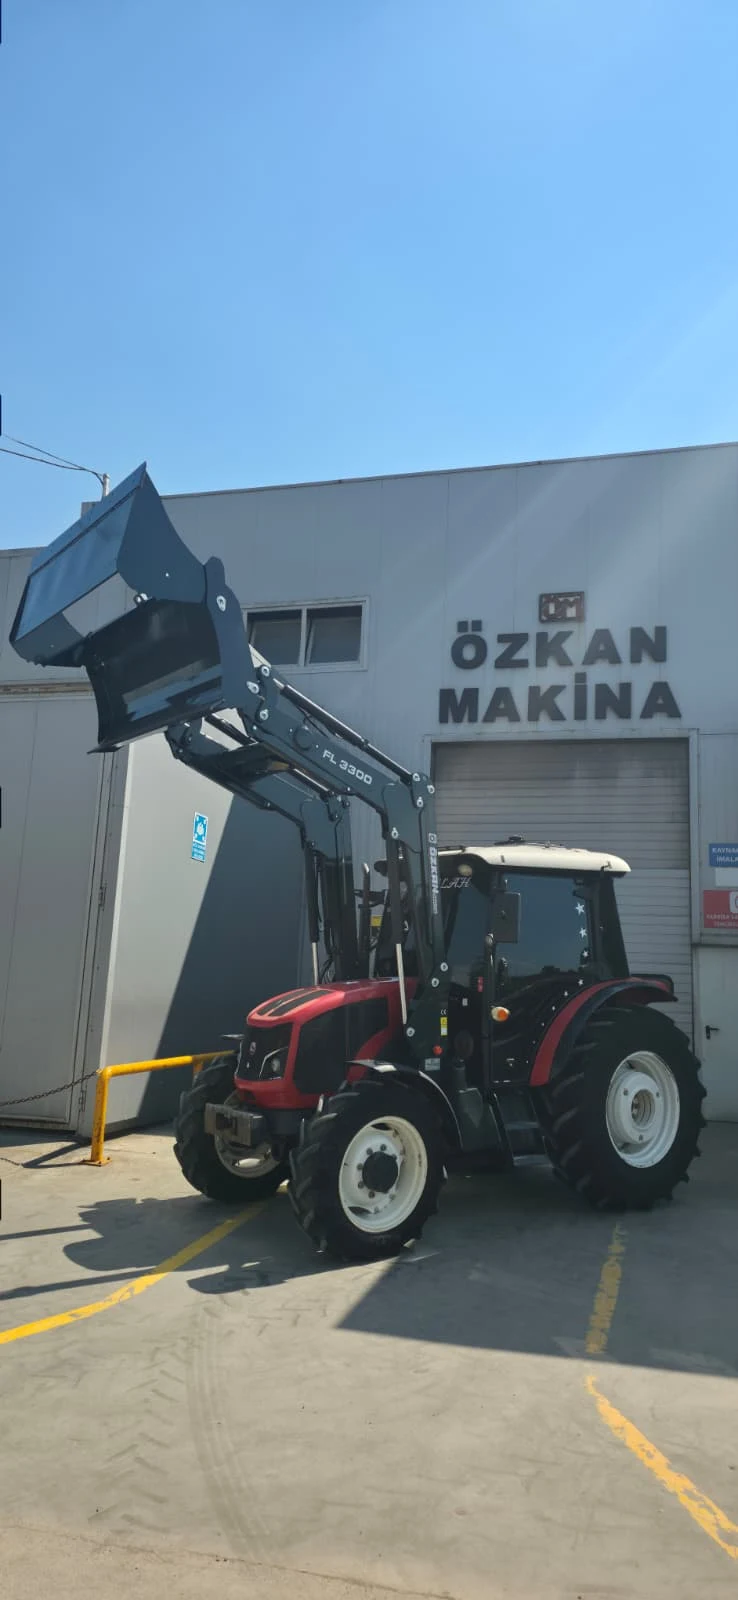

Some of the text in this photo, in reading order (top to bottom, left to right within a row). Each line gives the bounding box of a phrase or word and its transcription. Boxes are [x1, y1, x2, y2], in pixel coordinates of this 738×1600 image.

[451, 619, 667, 670] ÖZKAN
[439, 671, 682, 724] MAKİNA
[322, 749, 373, 785] FL 3300
